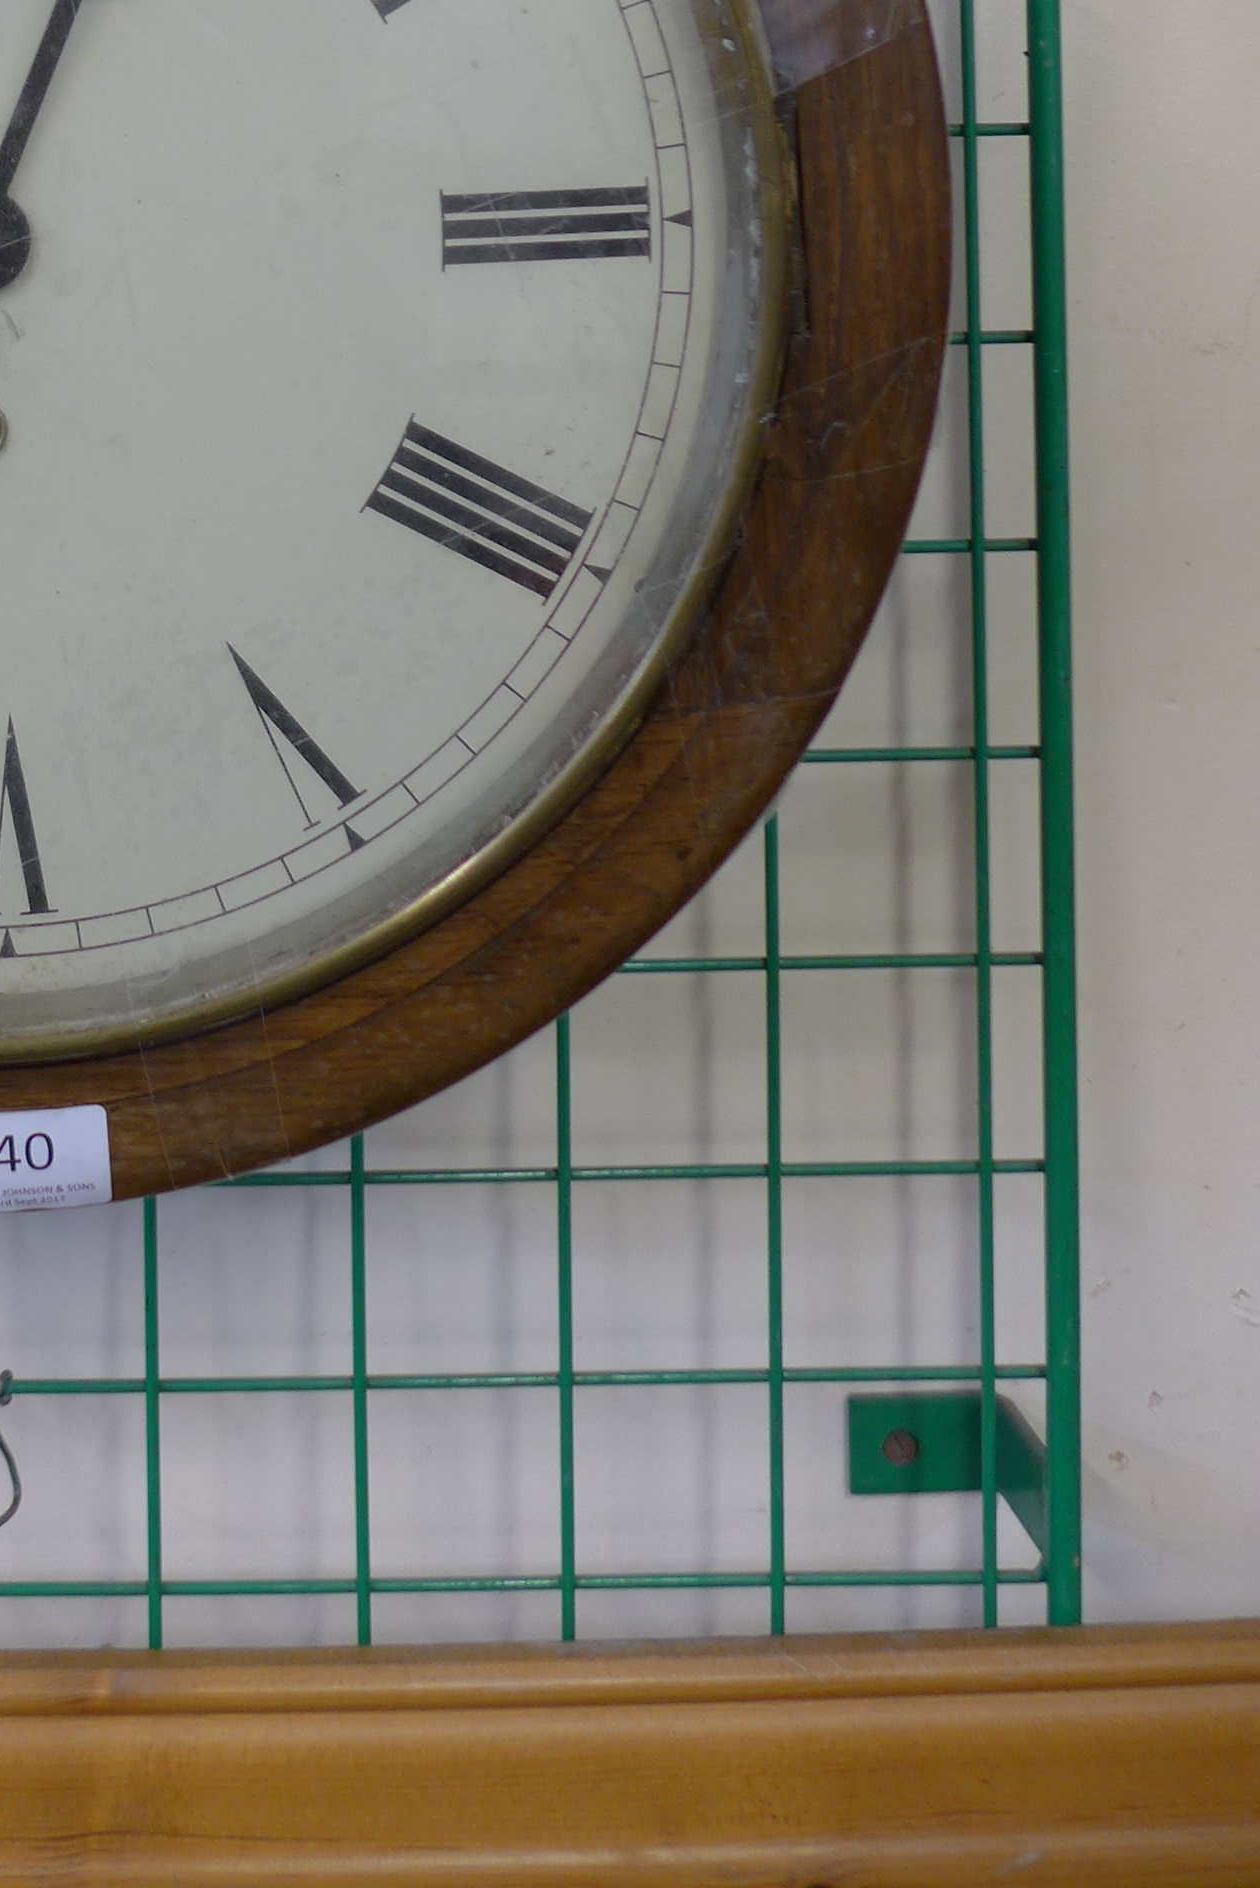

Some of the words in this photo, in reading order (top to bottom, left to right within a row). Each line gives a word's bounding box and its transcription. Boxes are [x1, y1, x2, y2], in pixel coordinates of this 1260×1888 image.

[440, 177, 651, 271] III
[359, 413, 596, 604] IIII
[226, 641, 368, 831] V
[2, 1185, 53, 1196] JOHNSON
[56, 1185, 63, 1193] &
[67, 1182, 96, 1192] SONS
